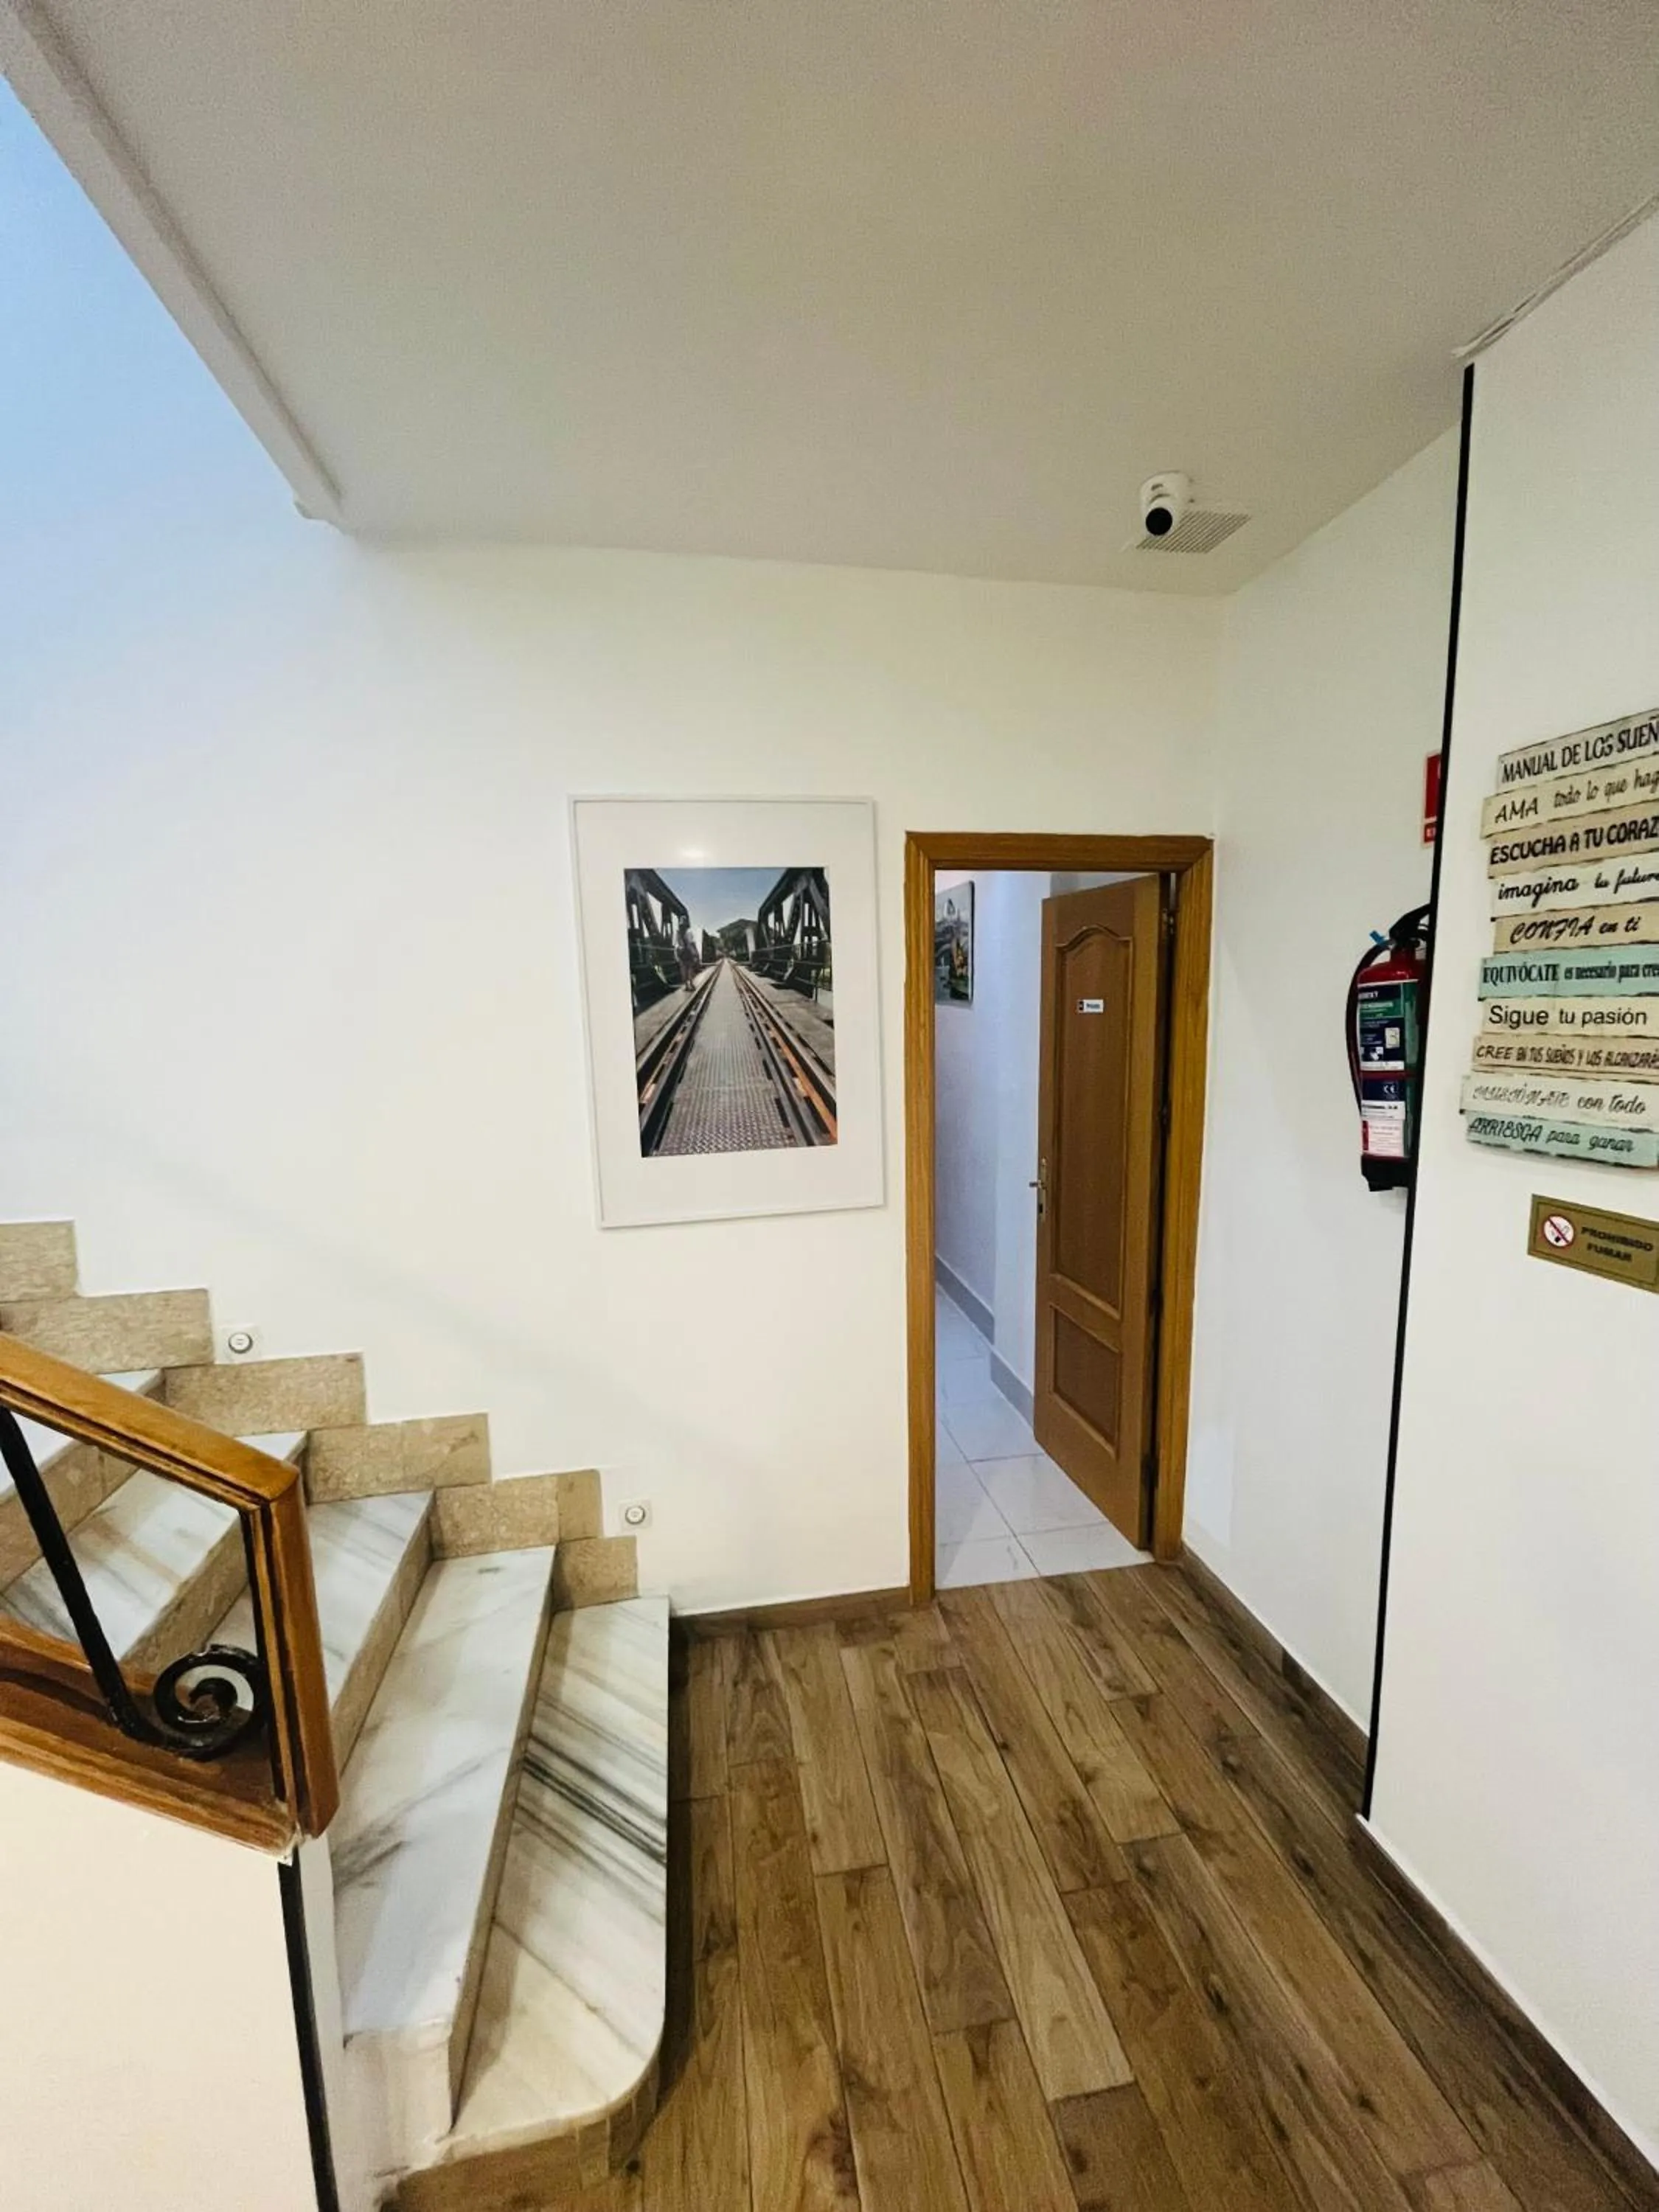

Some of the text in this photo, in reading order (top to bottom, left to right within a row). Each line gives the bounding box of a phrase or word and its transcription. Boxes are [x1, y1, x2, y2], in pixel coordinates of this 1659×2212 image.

[1502, 752, 1557, 783] MANUAL
[1561, 744, 1581, 768] DE
[1585, 733, 1613, 761] LOS
[1495, 797, 1539, 824] AMA
[1586, 780, 1599, 801] lo
[1604, 778, 1628, 803] que
[1489, 834, 1566, 865] ESCUCHA
[1569, 832, 1579, 852] A
[1584, 827, 1604, 849] TU
[1498, 877, 1579, 908] imagina
[1599, 922, 1618, 934] en
[1624, 916, 1641, 933] ti
[1482, 961, 1560, 987] EQUIVÓCATE
[1618, 964, 1640, 984] para
[1488, 1005, 1647, 1029] Sigue tu pasión
[1476, 1045, 1514, 1060] CREE
[1577, 1096, 1604, 1112] con
[1467, 1117, 1634, 1153] ARRIESGA para ganar
